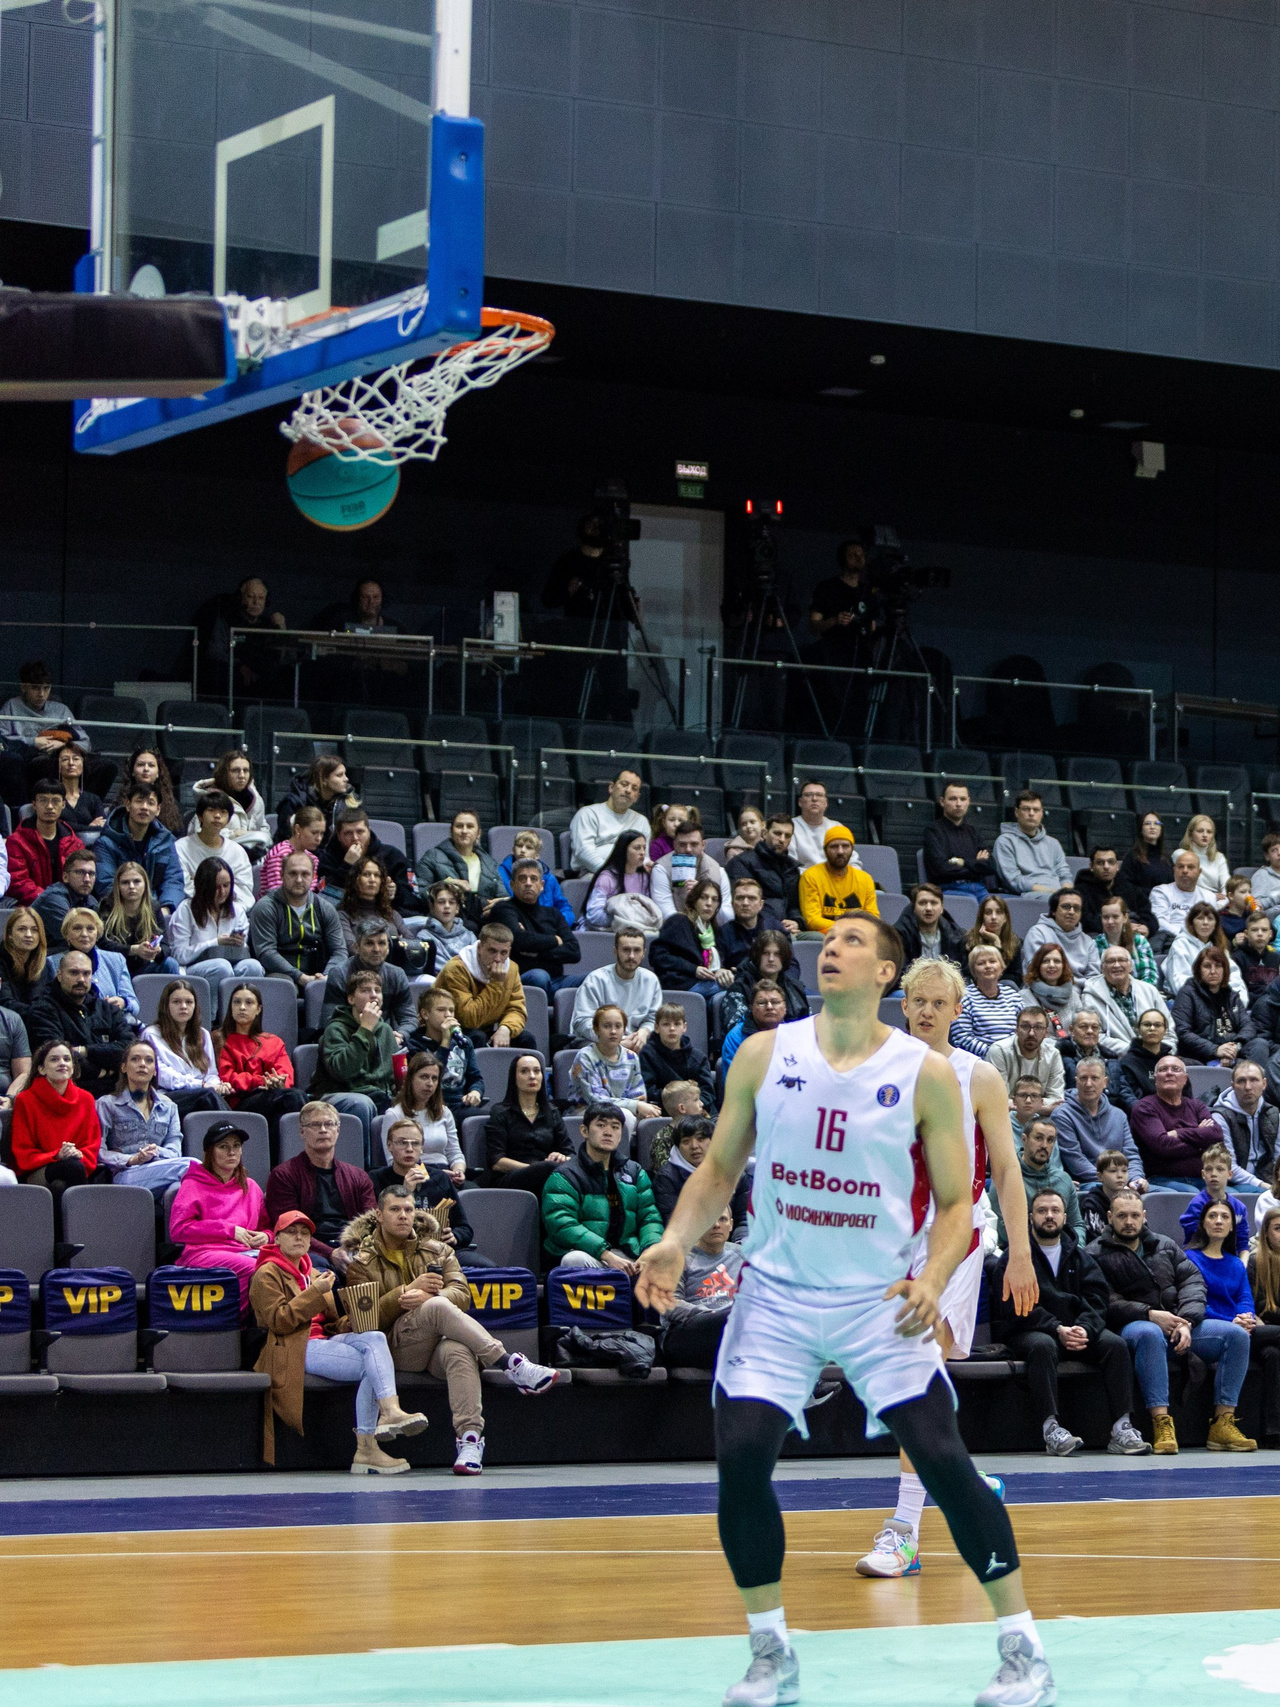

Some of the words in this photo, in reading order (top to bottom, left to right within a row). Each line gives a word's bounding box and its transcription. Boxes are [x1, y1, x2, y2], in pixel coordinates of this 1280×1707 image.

[677, 464, 707, 477] ВЫХОД
[815, 1106, 848, 1152] 16
[771, 1161, 881, 1197] BetBoom
[62, 1285, 122, 1314] VIP
[167, 1284, 225, 1311] VIP
[469, 1283, 523, 1310] VIP
[562, 1283, 616, 1310] VIP
